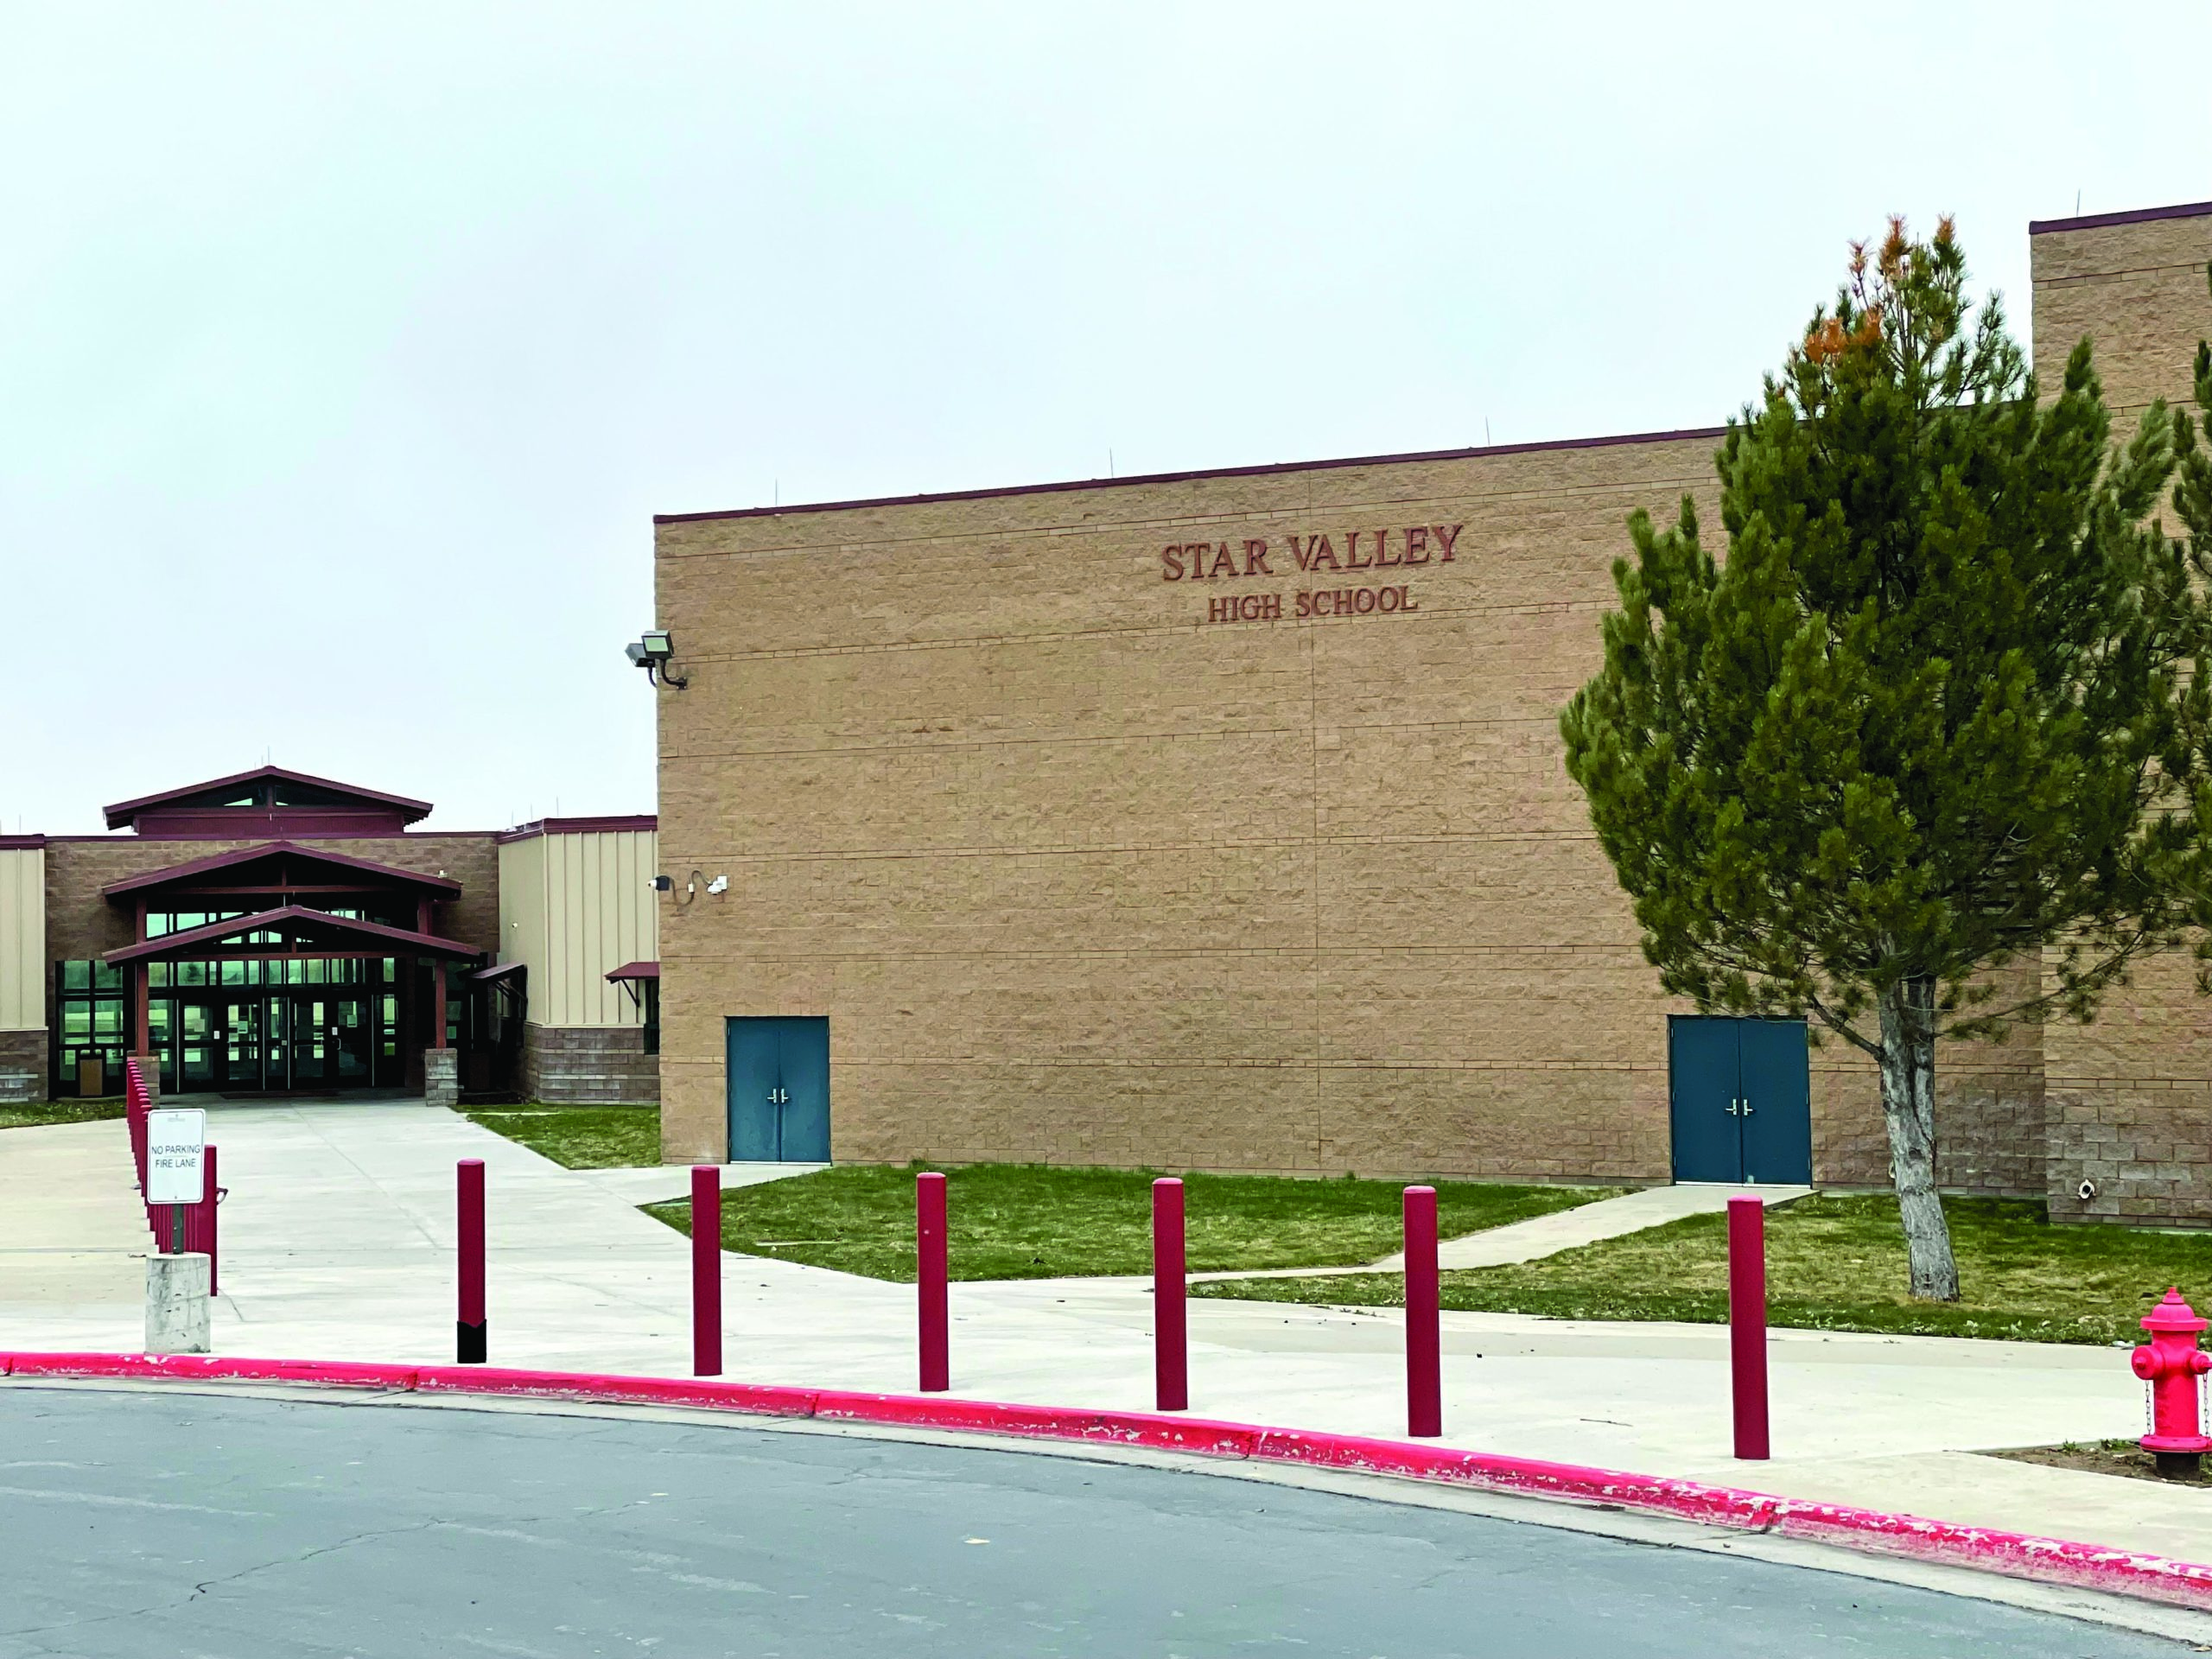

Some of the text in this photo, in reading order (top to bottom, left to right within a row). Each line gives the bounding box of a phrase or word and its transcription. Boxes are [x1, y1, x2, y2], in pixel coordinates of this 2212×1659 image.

[1162, 524, 1465, 581] STAR VALLEY
[1208, 585, 1419, 622] HIGH SCHOOL
[151, 1144, 200, 1154] NO PARKING
[156, 1158, 196, 1168] FIRE LANE
